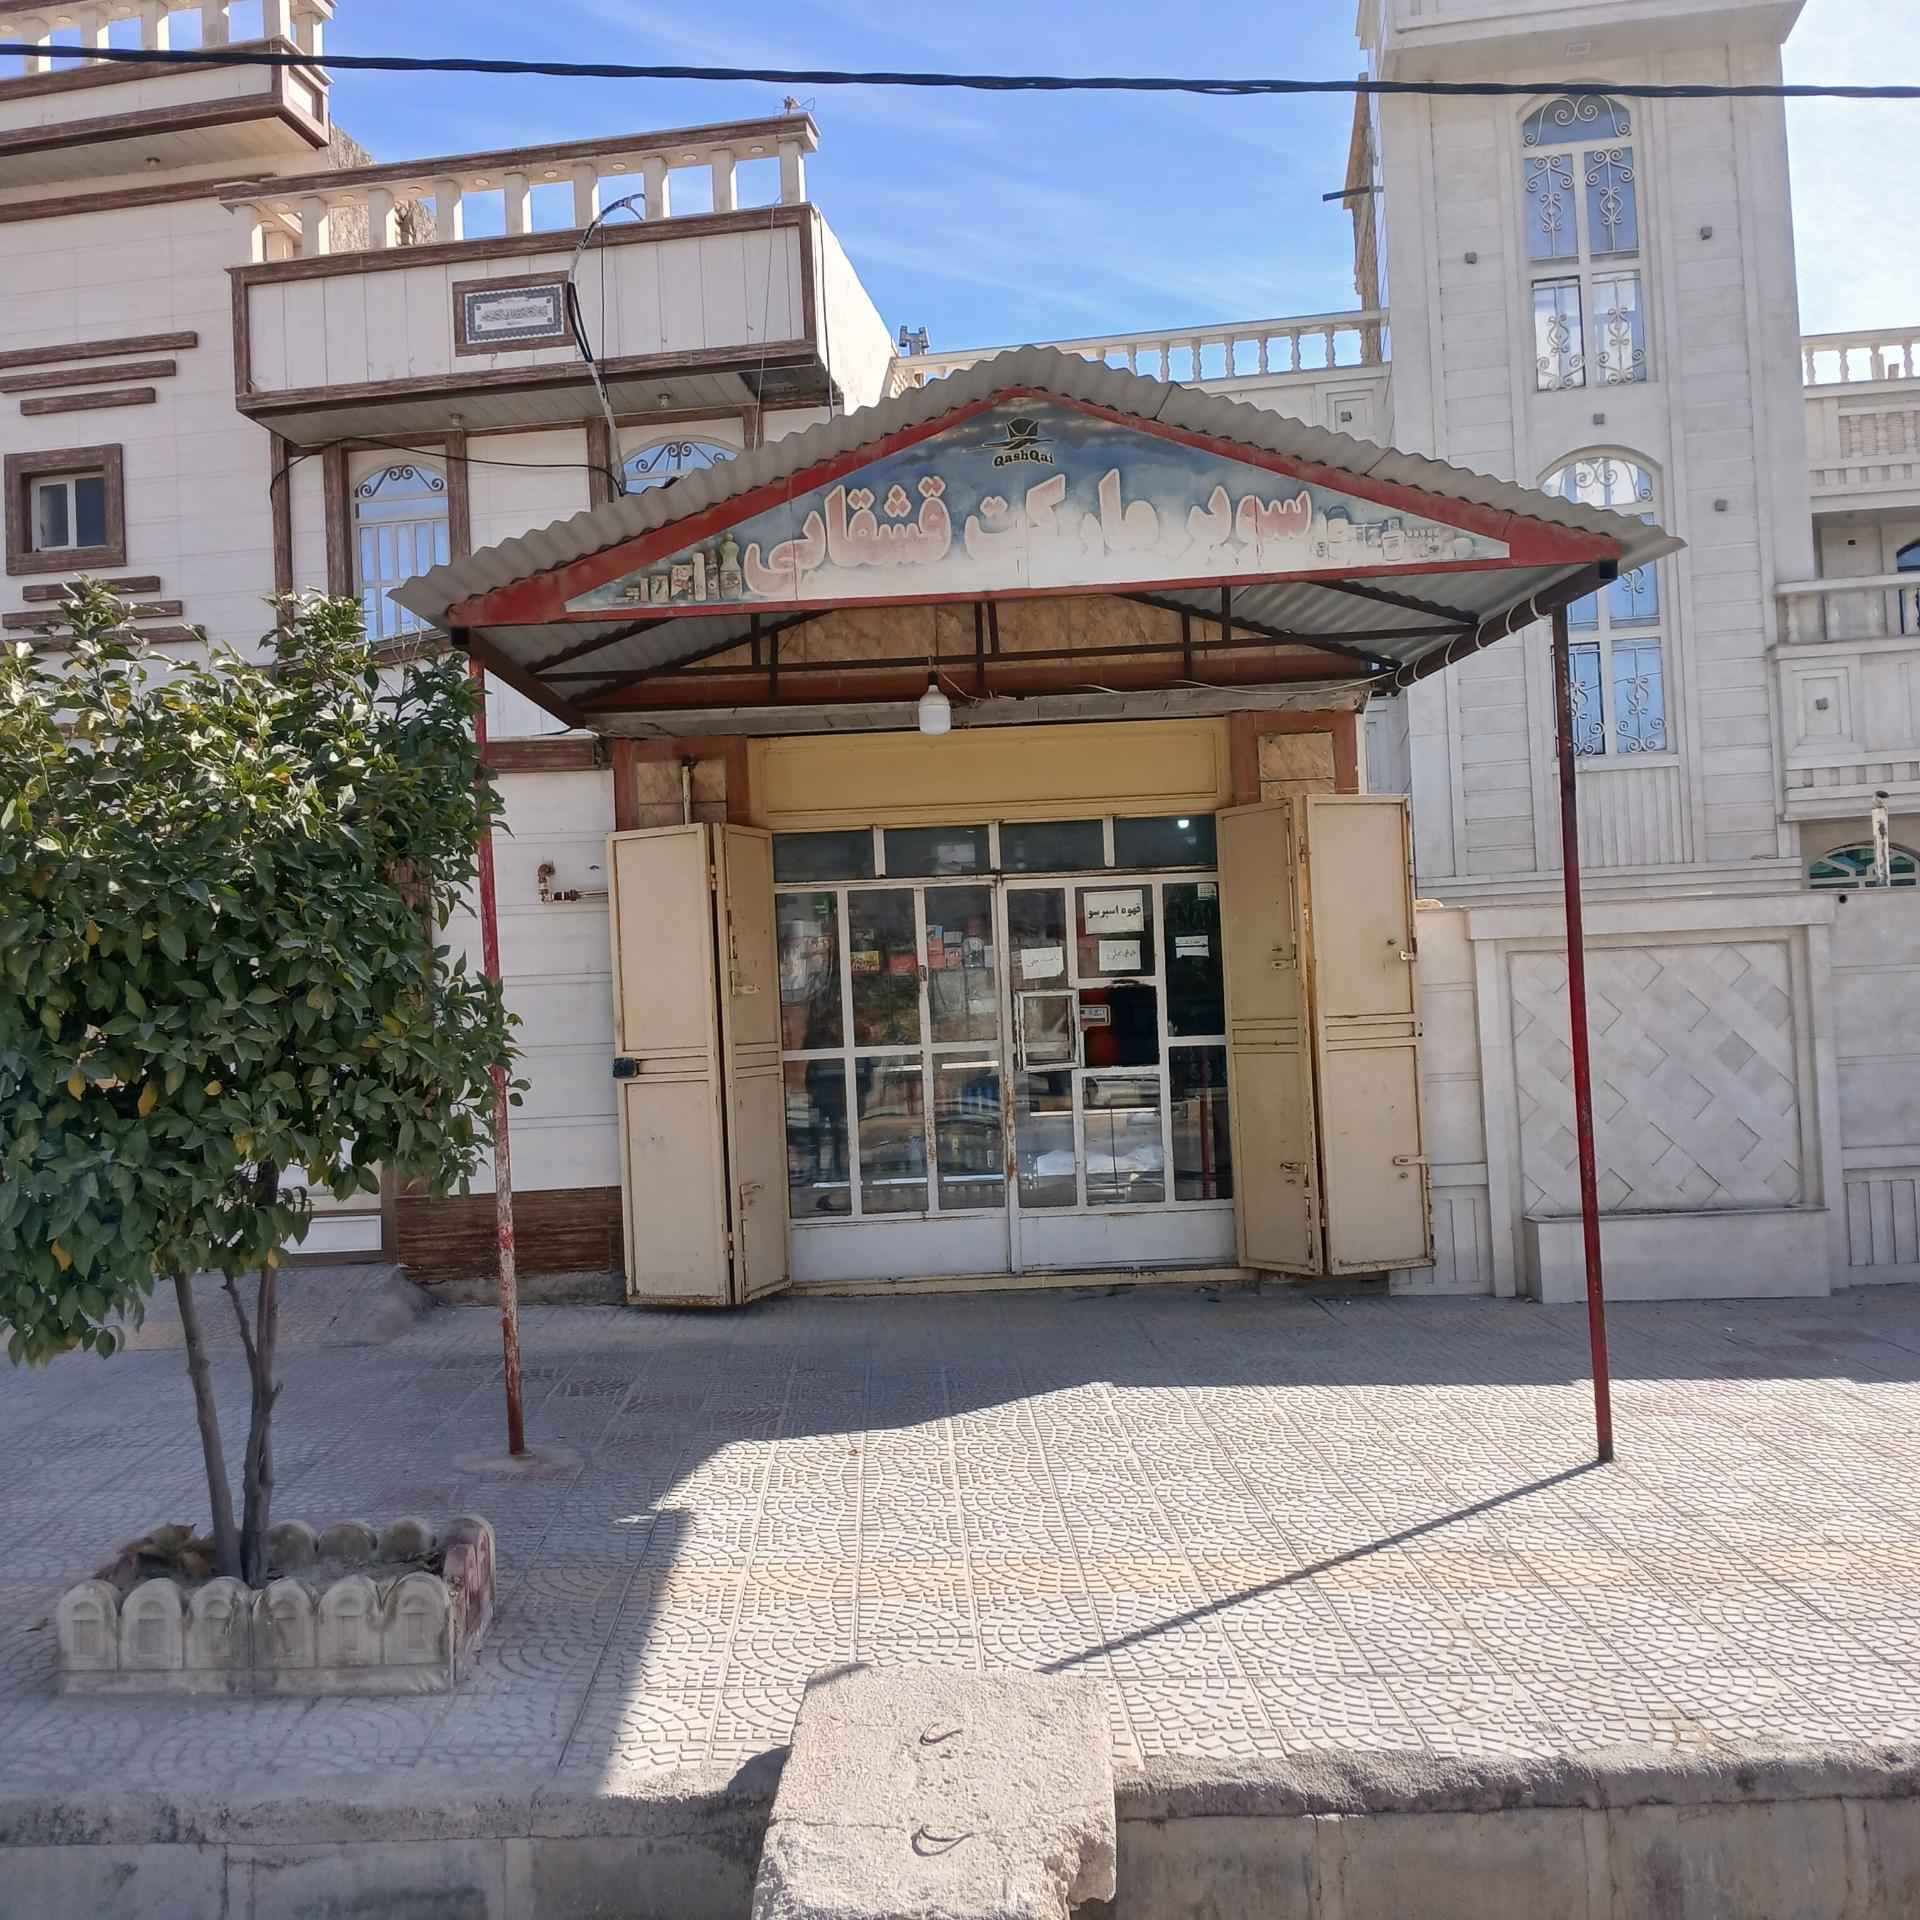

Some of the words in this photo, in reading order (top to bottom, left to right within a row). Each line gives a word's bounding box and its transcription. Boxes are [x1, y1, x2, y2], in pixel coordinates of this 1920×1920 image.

[993, 448, 1055, 468] QashQai
[744, 475, 951, 596] قشقایی
[964, 468, 1161, 562] مارکت
[1120, 903, 1142, 917] قهوه
